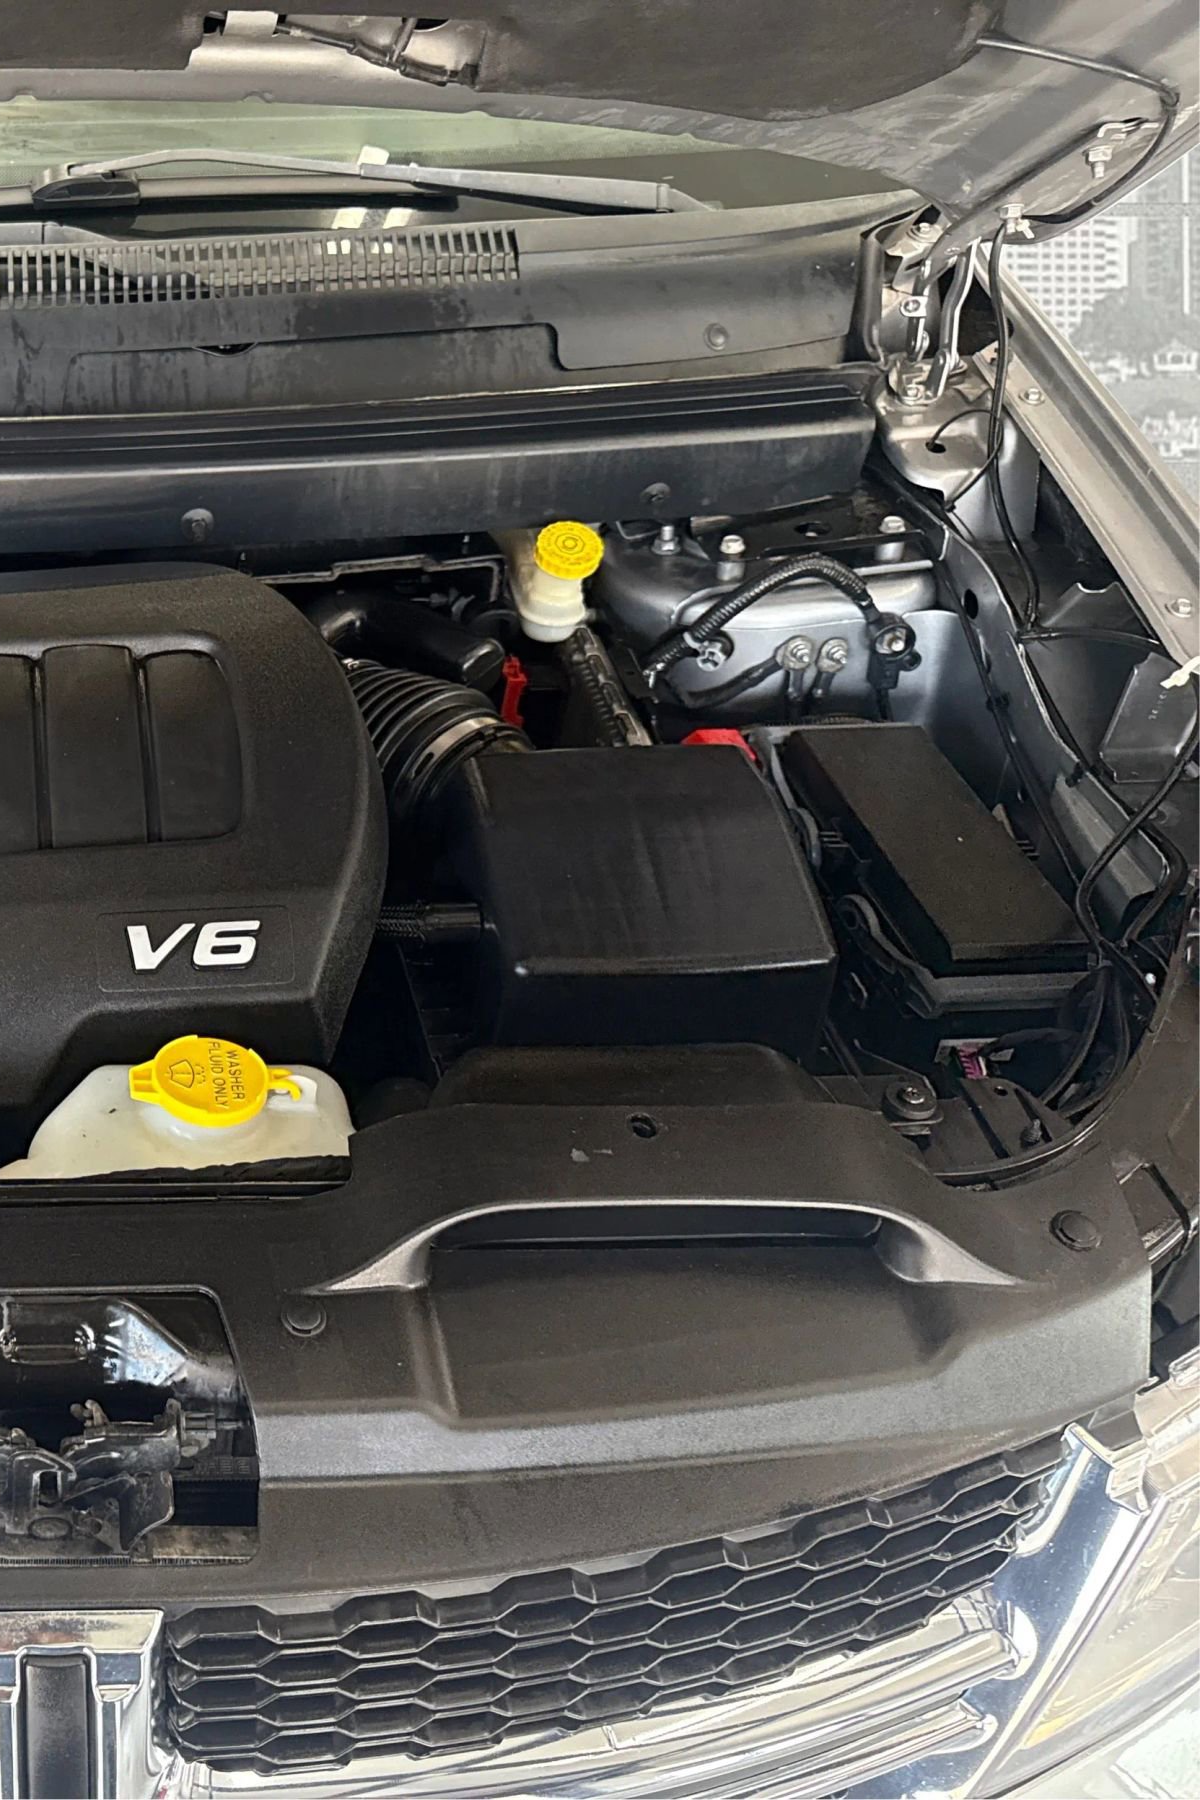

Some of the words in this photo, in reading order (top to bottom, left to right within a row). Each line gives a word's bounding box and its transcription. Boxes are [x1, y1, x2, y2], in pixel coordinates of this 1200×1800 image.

[125, 920, 261, 973] V6
[208, 1041, 224, 1074] FLUID
[226, 1050, 246, 1100] WASHER
[213, 1077, 230, 1108] ONLY
